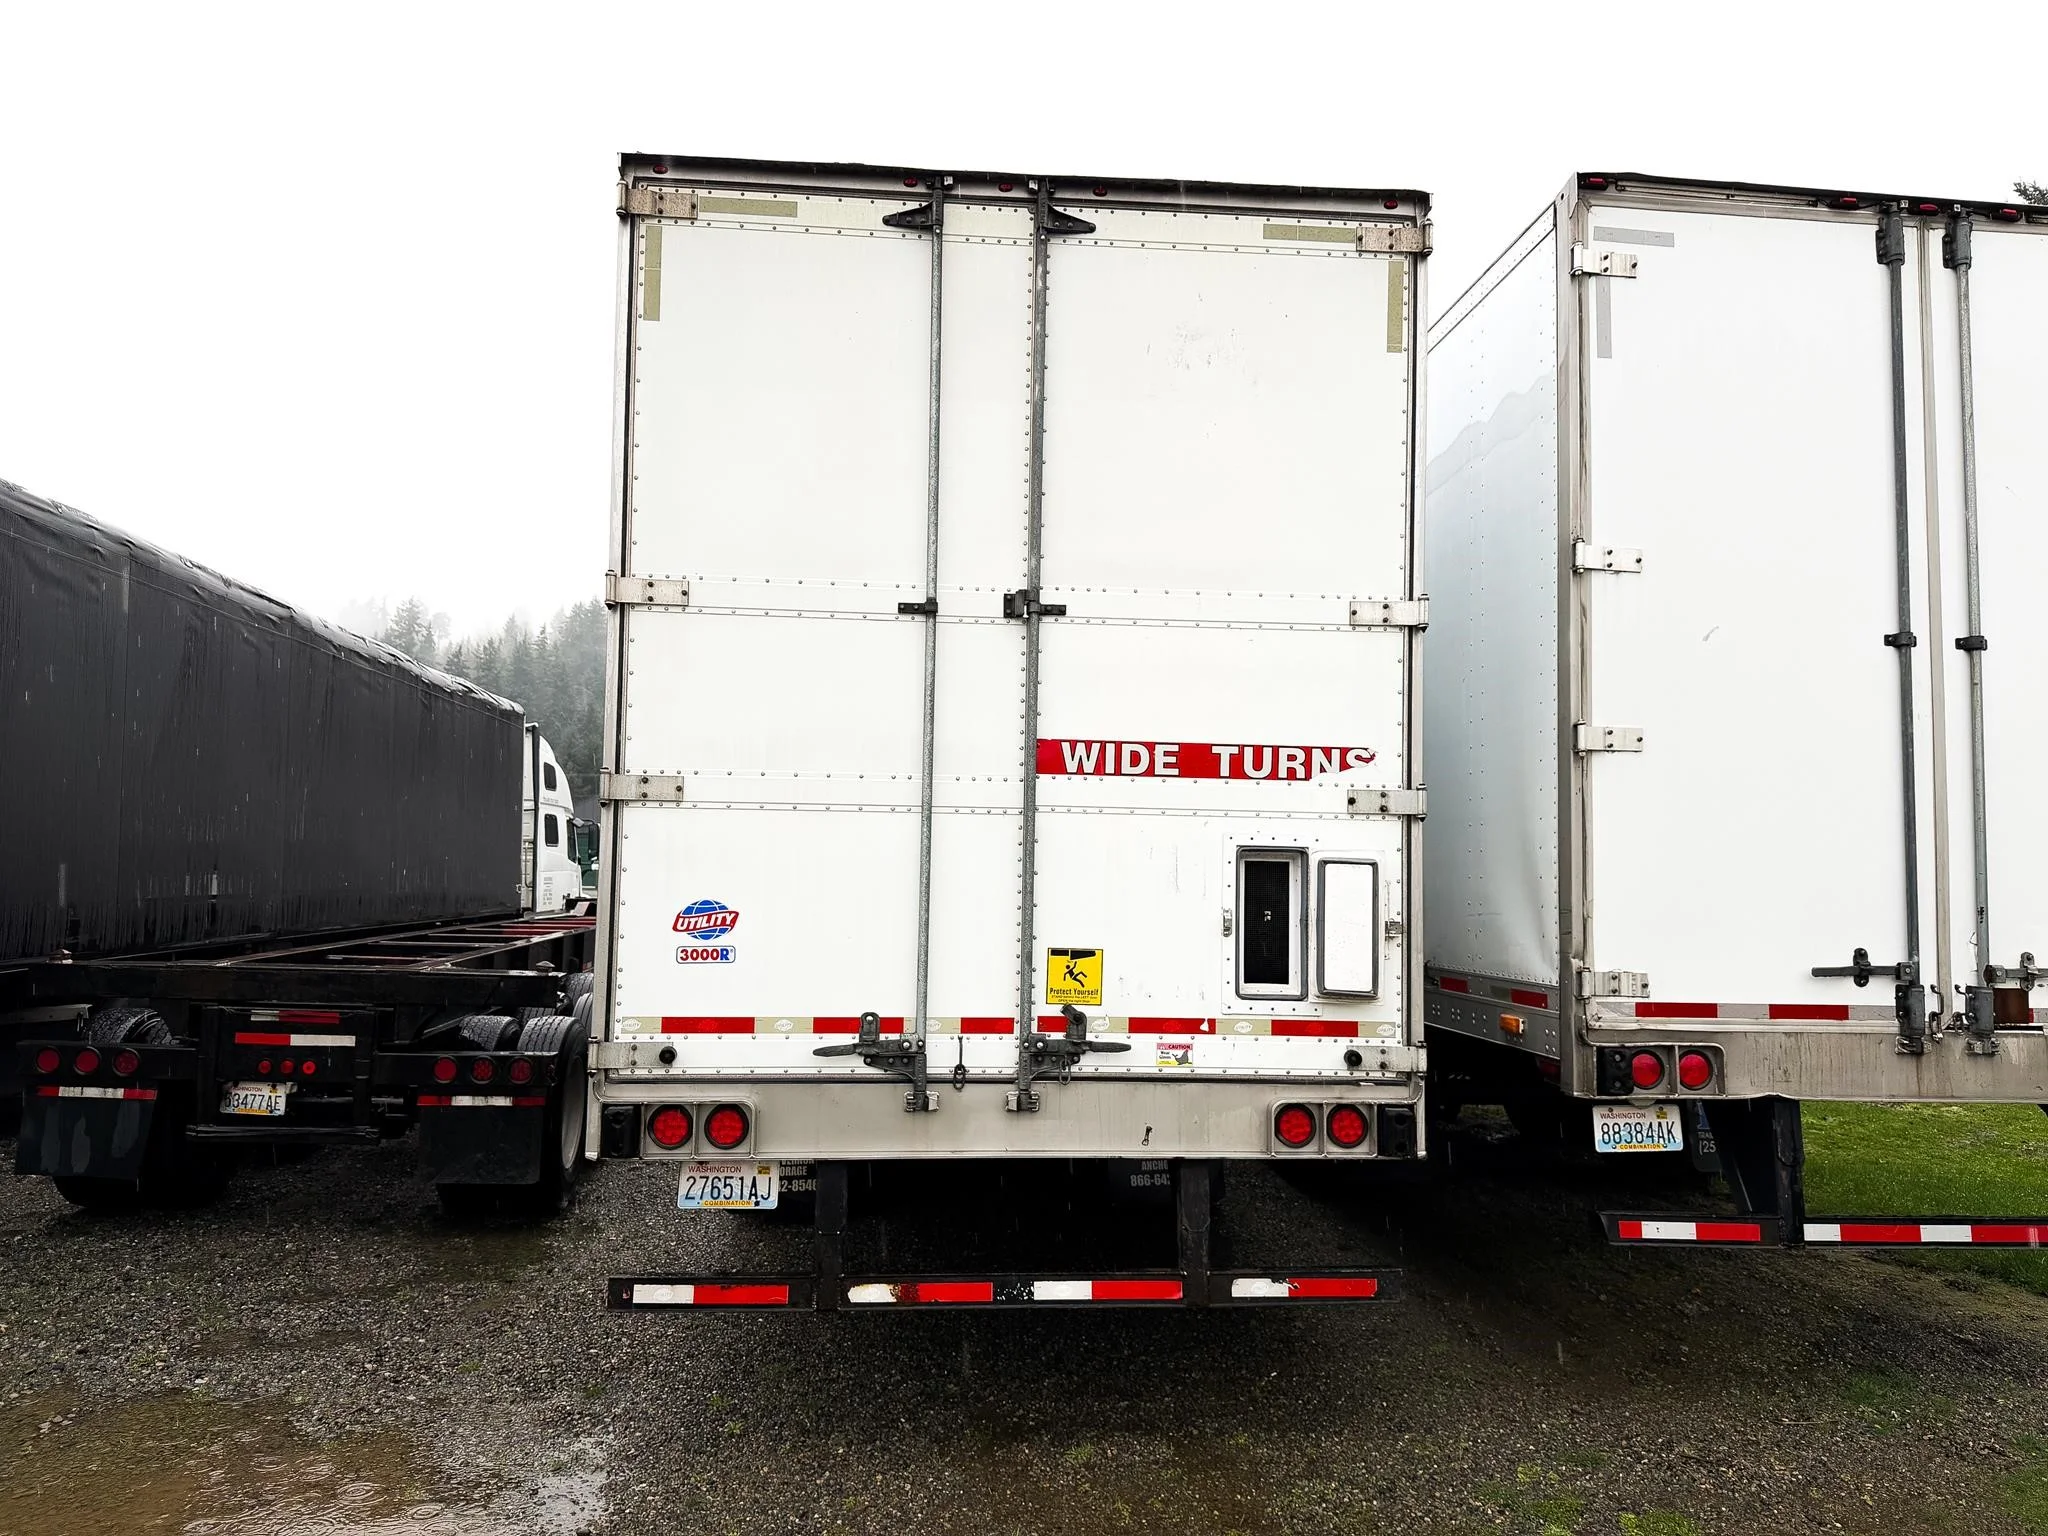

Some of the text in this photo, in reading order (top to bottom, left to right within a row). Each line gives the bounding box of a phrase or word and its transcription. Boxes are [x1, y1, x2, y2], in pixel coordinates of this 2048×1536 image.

[1060, 740, 1181, 777] WIDE
[676, 913, 736, 930] UTILITY
[1600, 1111, 1646, 1120] WASHINGTON
[1600, 1120, 1677, 1145] 88384AK
[687, 1165, 742, 1174] WASHINGTON
[684, 1175, 772, 1201] 27651AJ
